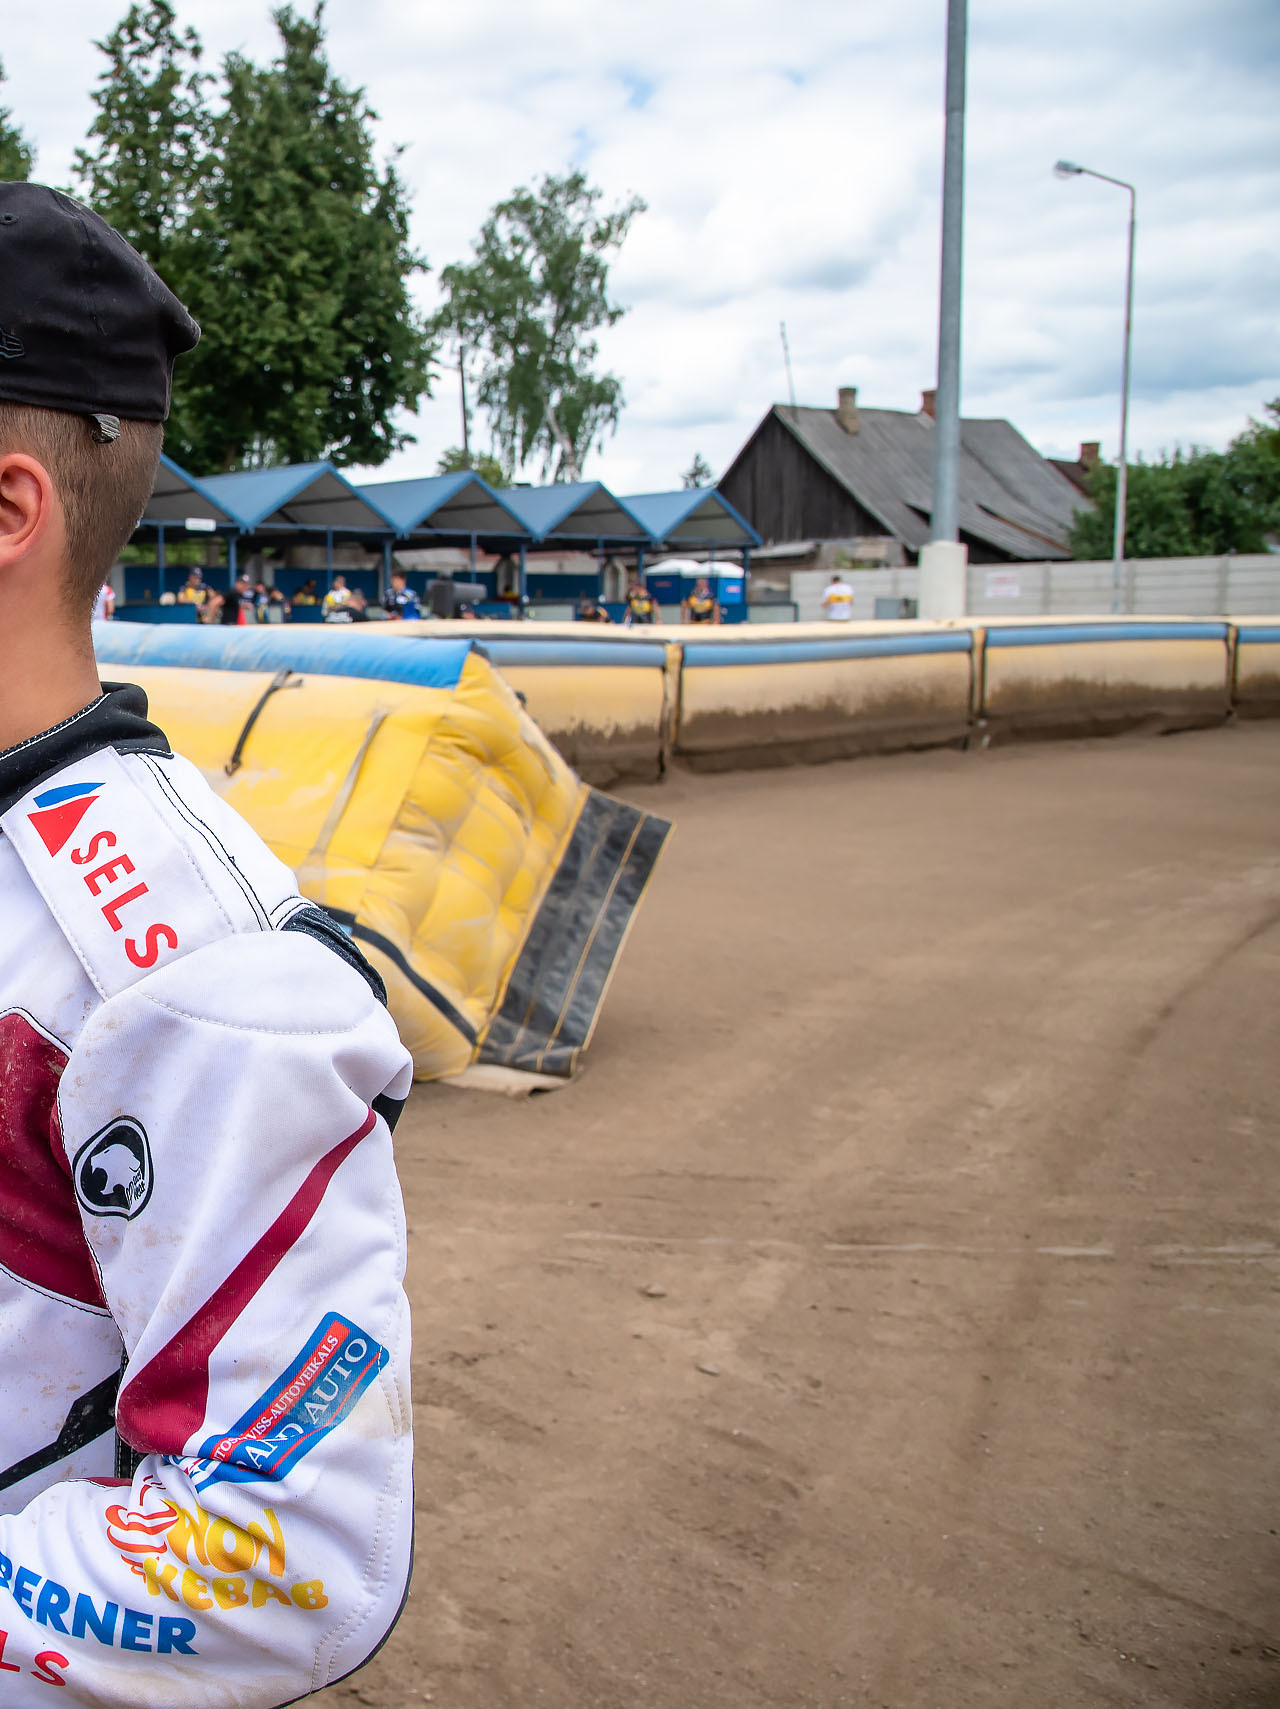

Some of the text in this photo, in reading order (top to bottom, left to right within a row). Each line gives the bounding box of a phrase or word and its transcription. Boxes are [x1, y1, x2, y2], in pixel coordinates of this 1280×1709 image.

[71, 831, 178, 968] SELS
[305, 1337, 368, 1425] AUTO
[143, 1557, 329, 1610] KEBAB
